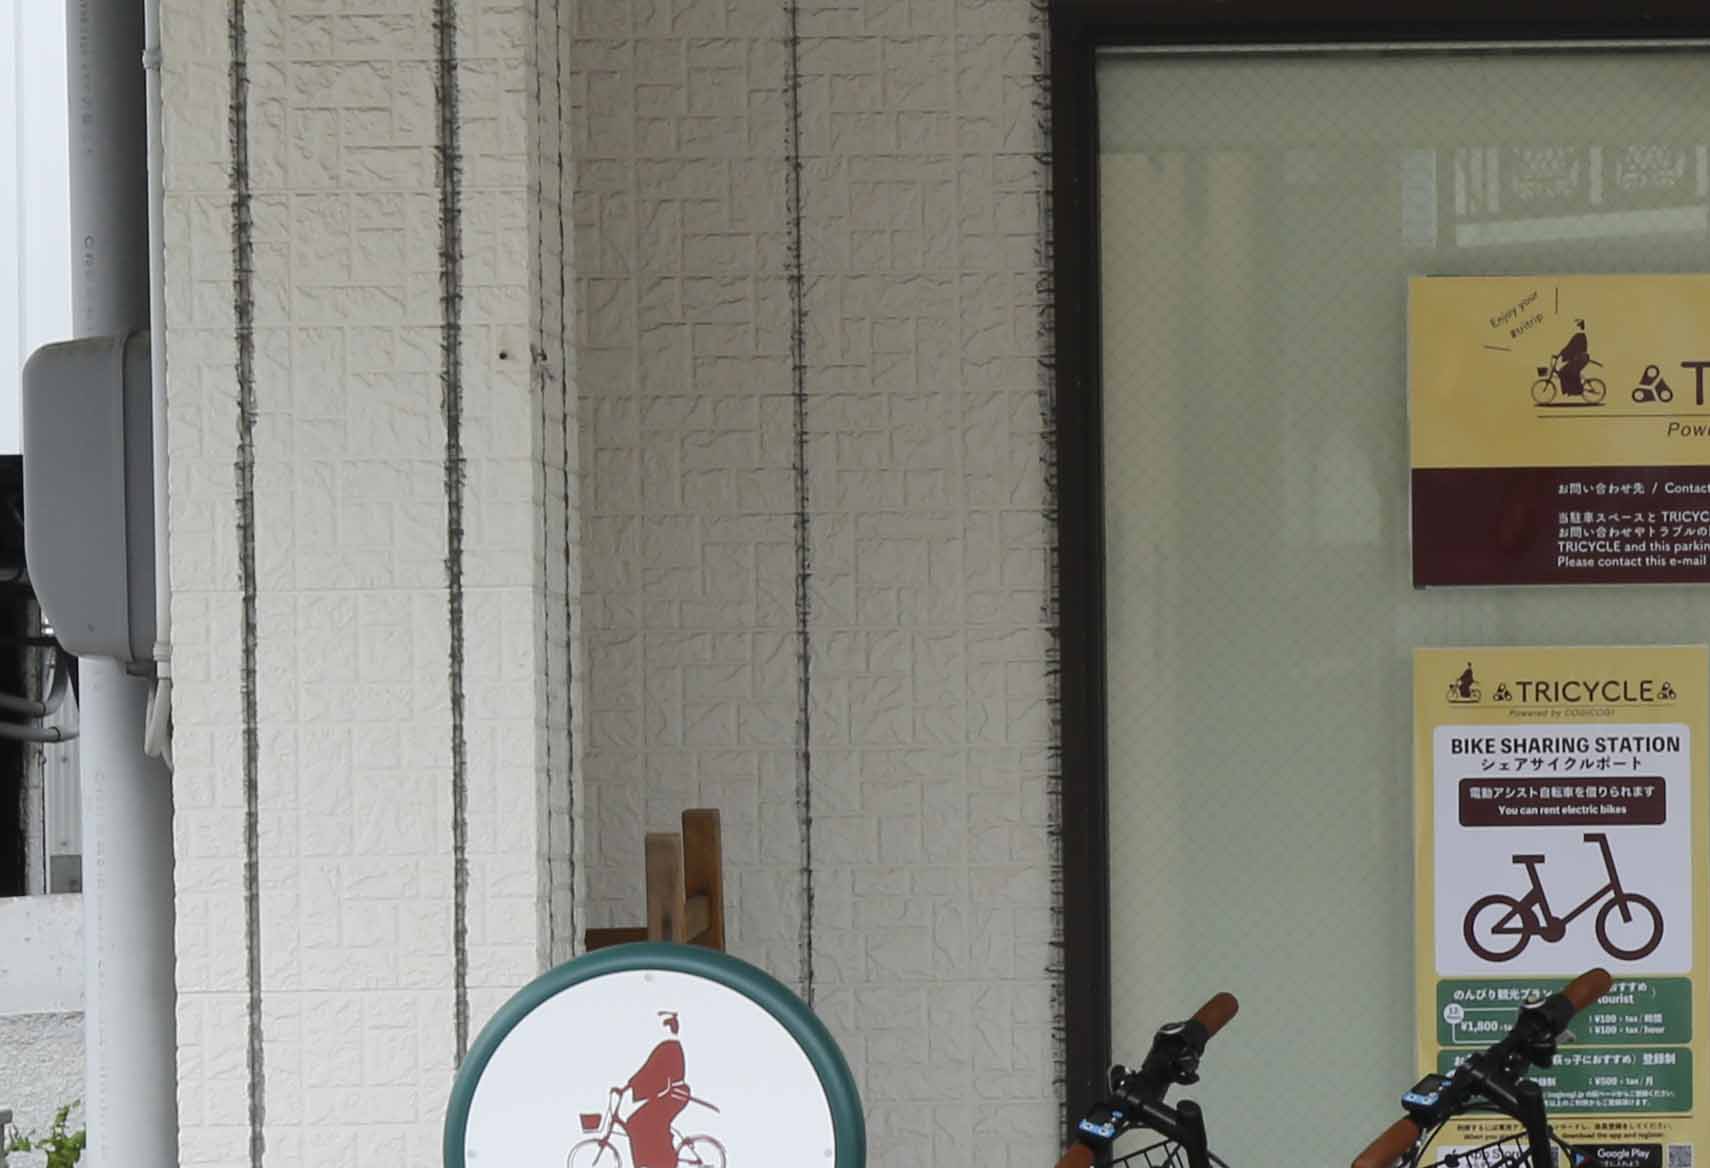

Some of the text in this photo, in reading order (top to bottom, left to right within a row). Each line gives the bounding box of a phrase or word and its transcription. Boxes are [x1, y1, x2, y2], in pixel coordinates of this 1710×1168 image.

[1558, 482, 1645, 495] お問い合わせ先
[1558, 541, 1621, 552] TRICYCLE
[1625, 541, 1646, 552] and
[1650, 540, 1670, 551] this
[1557, 556, 1594, 567] Please
[1598, 556, 1642, 567] contact
[1645, 556, 1666, 566] this
[1670, 555, 1706, 566] e-mail
[1515, 680, 1654, 702] TRICYCLE
[1451, 736, 1680, 755] BIKE SHARING STATION
[1481, 757, 1642, 771] シェアサイクルポート
[1470, 786, 1655, 799] 電動アシスト自転車を借りられます
[1498, 804, 1627, 815] You can rent electric bikes
[1597, 1148, 1650, 1159] Google Play
